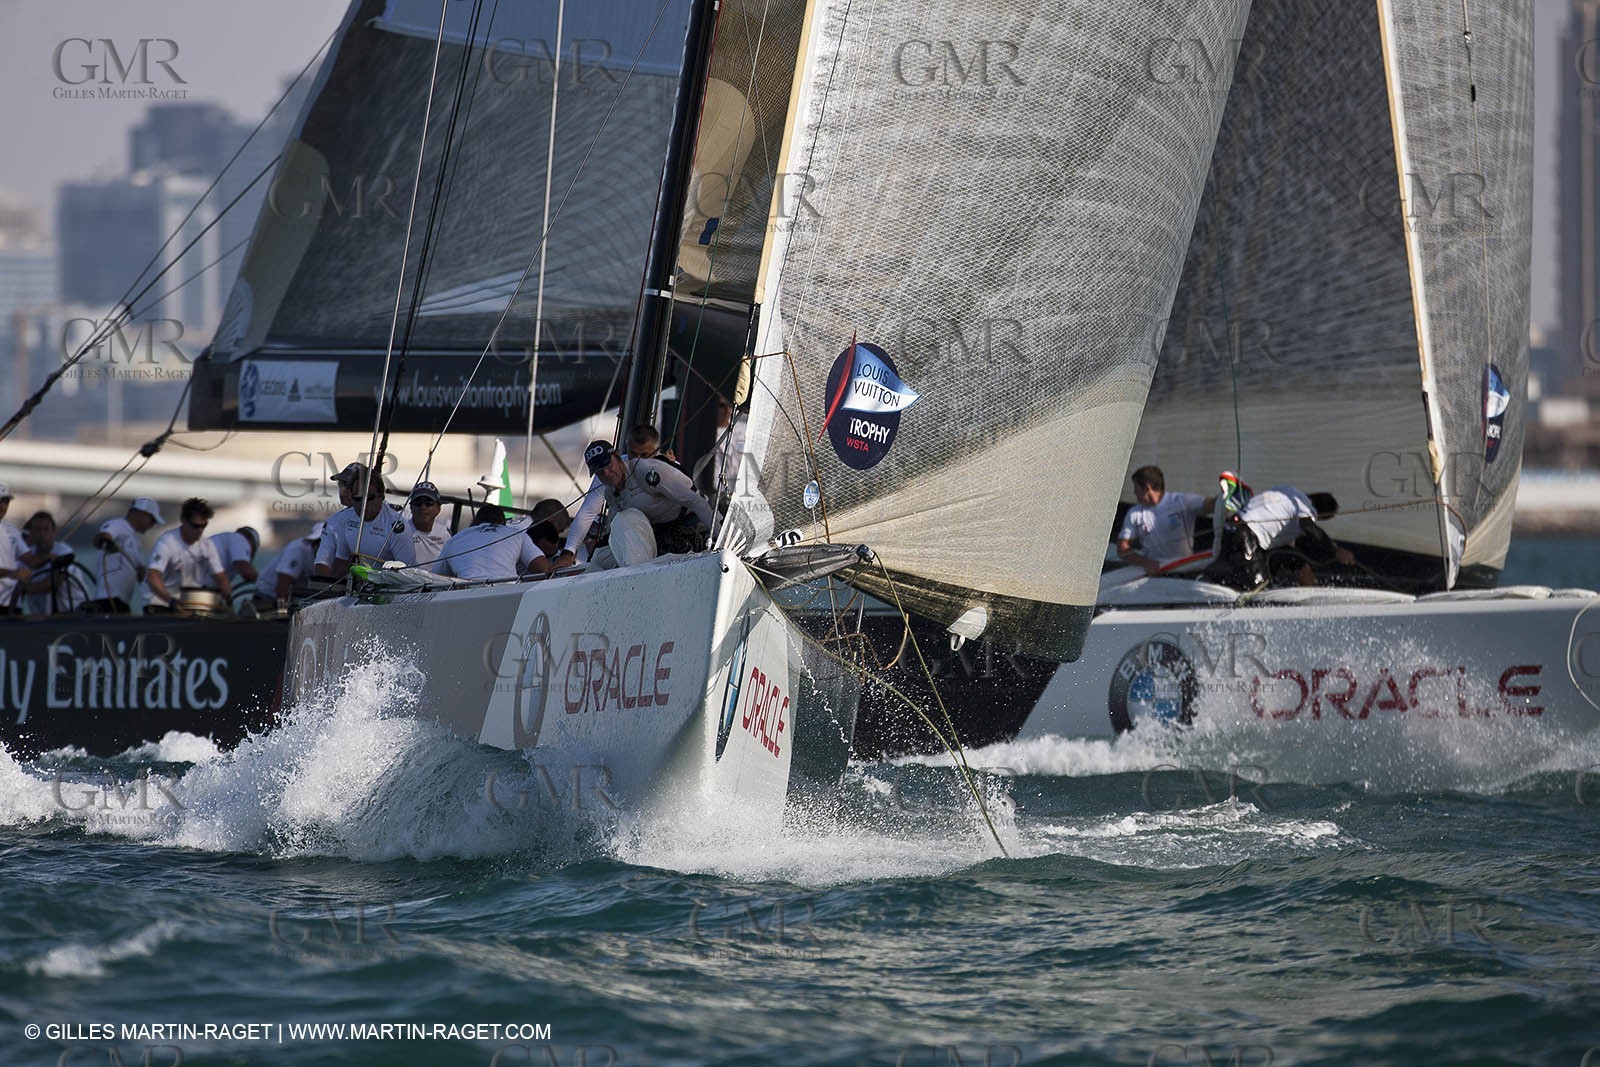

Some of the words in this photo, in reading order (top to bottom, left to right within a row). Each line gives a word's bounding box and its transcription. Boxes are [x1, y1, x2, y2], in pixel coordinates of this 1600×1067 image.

[852, 380, 901, 407] VUITTON
[856, 362, 890, 384] LOUIS
[846, 437, 869, 451] WSTA
[848, 417, 890, 444] TROPHY
[46, 639, 229, 710] Emirates
[564, 641, 675, 714] ORACLE
[1248, 663, 1545, 721] ORACLE
[742, 665, 790, 758] ORACLE
